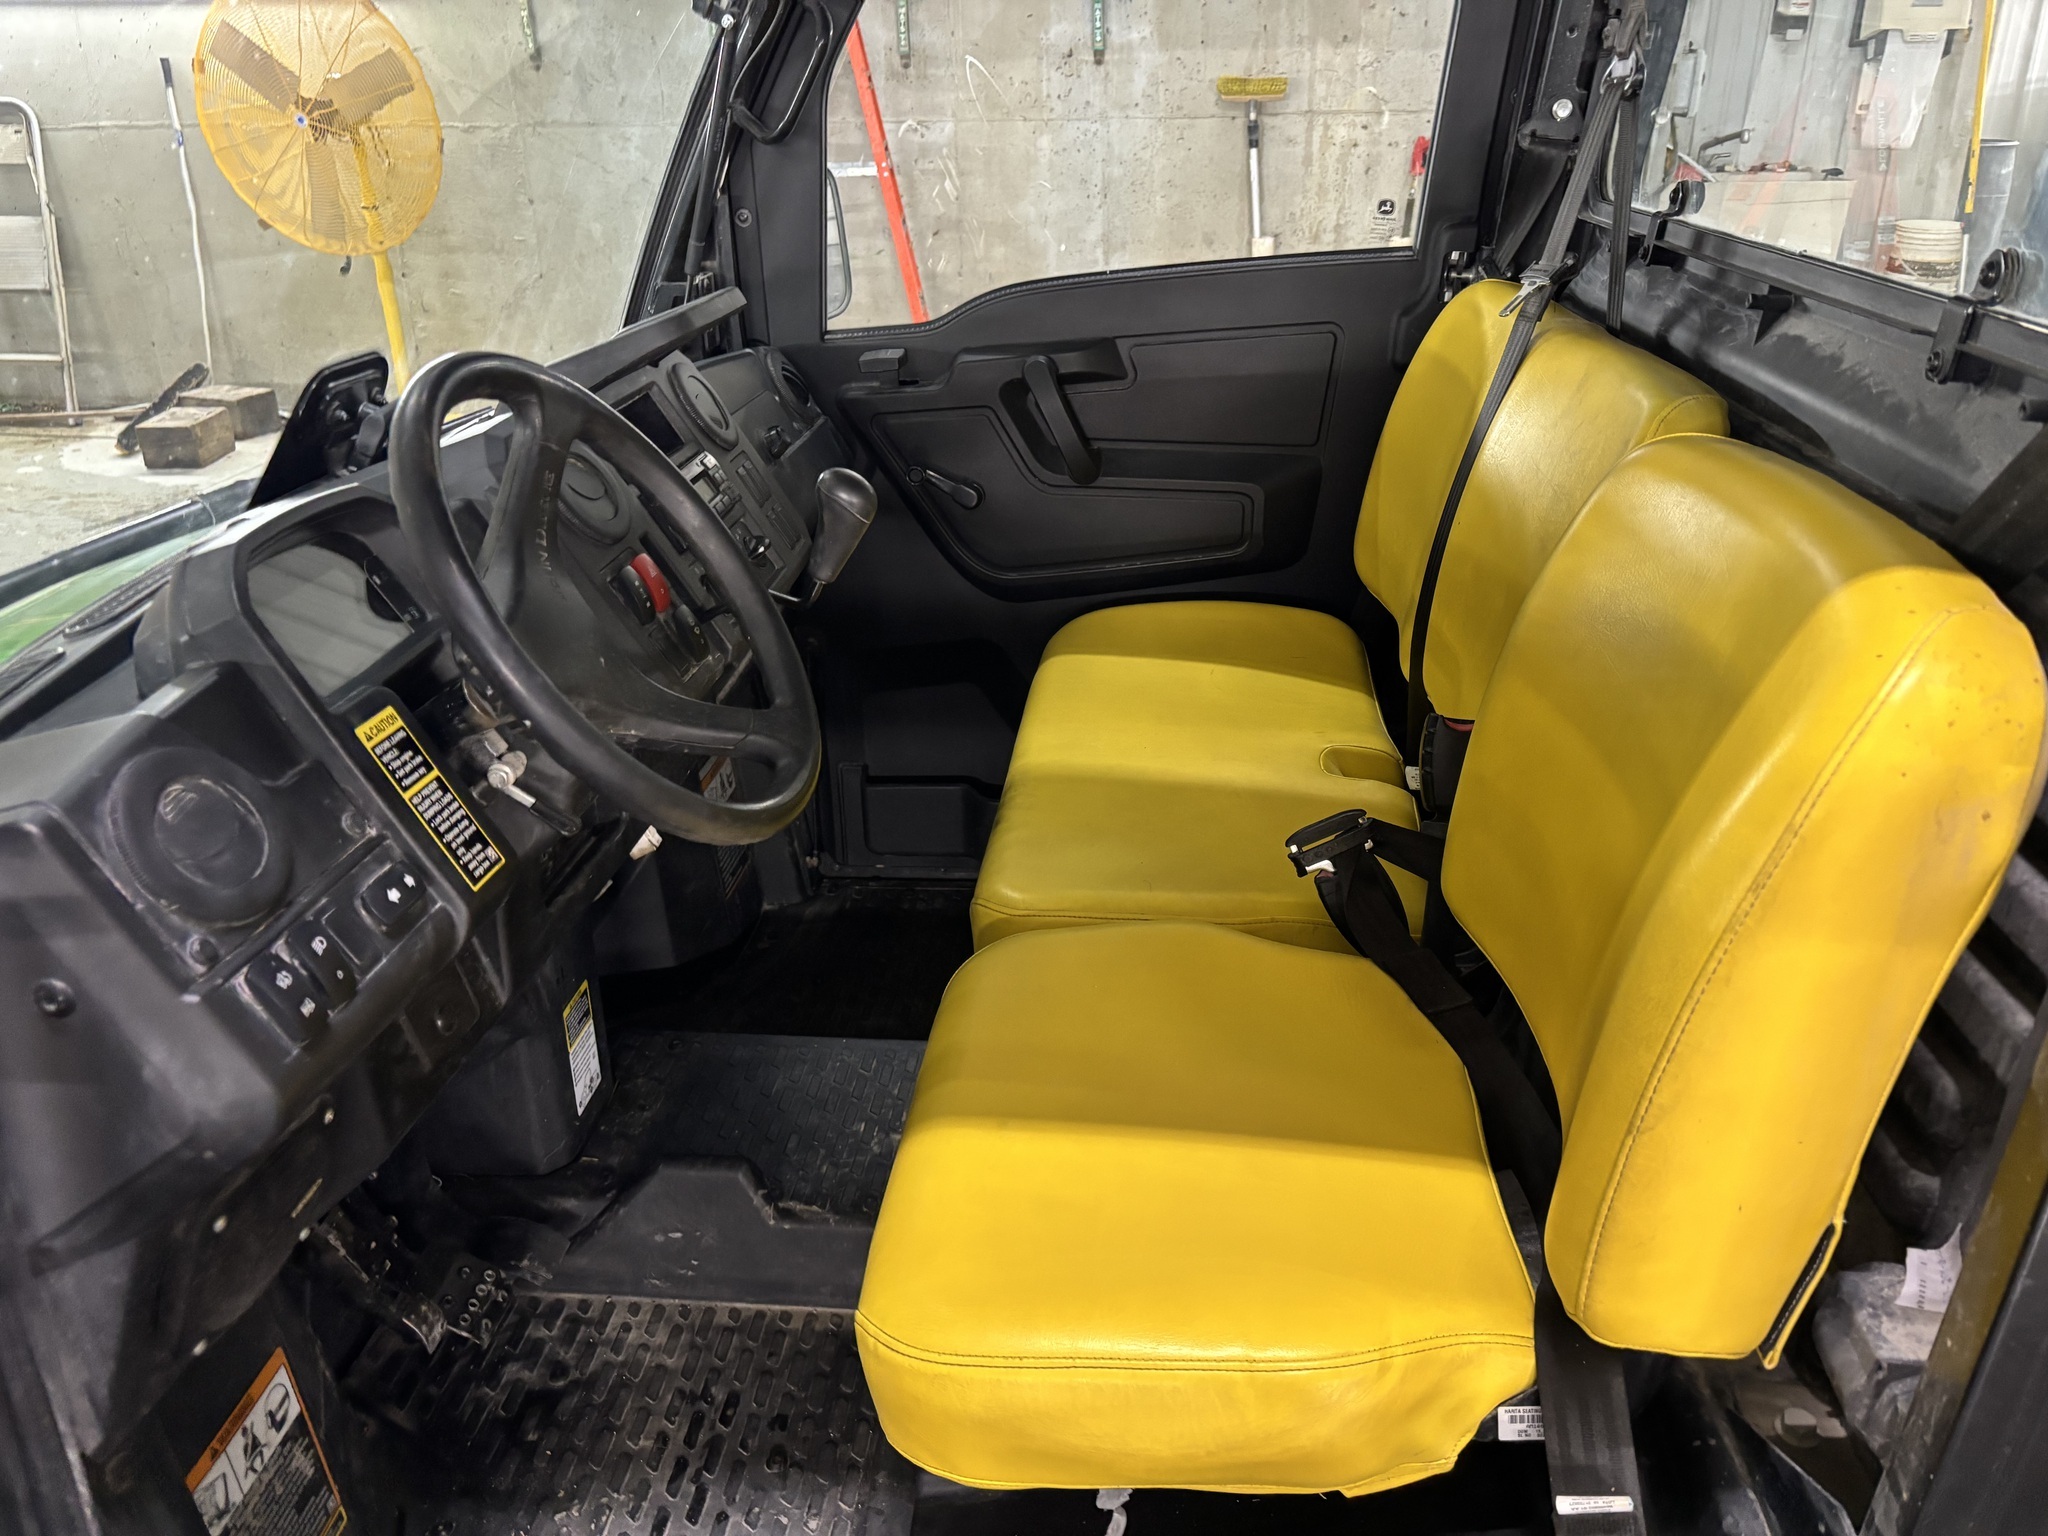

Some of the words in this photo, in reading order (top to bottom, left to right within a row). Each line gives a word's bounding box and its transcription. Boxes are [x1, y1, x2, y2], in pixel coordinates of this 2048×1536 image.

[370, 713, 399, 737] CAUTION
[373, 739, 392, 755] BEFORE
[388, 728, 407, 745] LEAVING
[410, 792, 424, 805] HELP
[420, 780, 439, 797] PREVENT
[416, 798, 433, 812] INJURY
[430, 788, 443, 802] WHEN
[422, 801, 442, 819] DUMPING
[438, 792, 454, 806] LOADS
